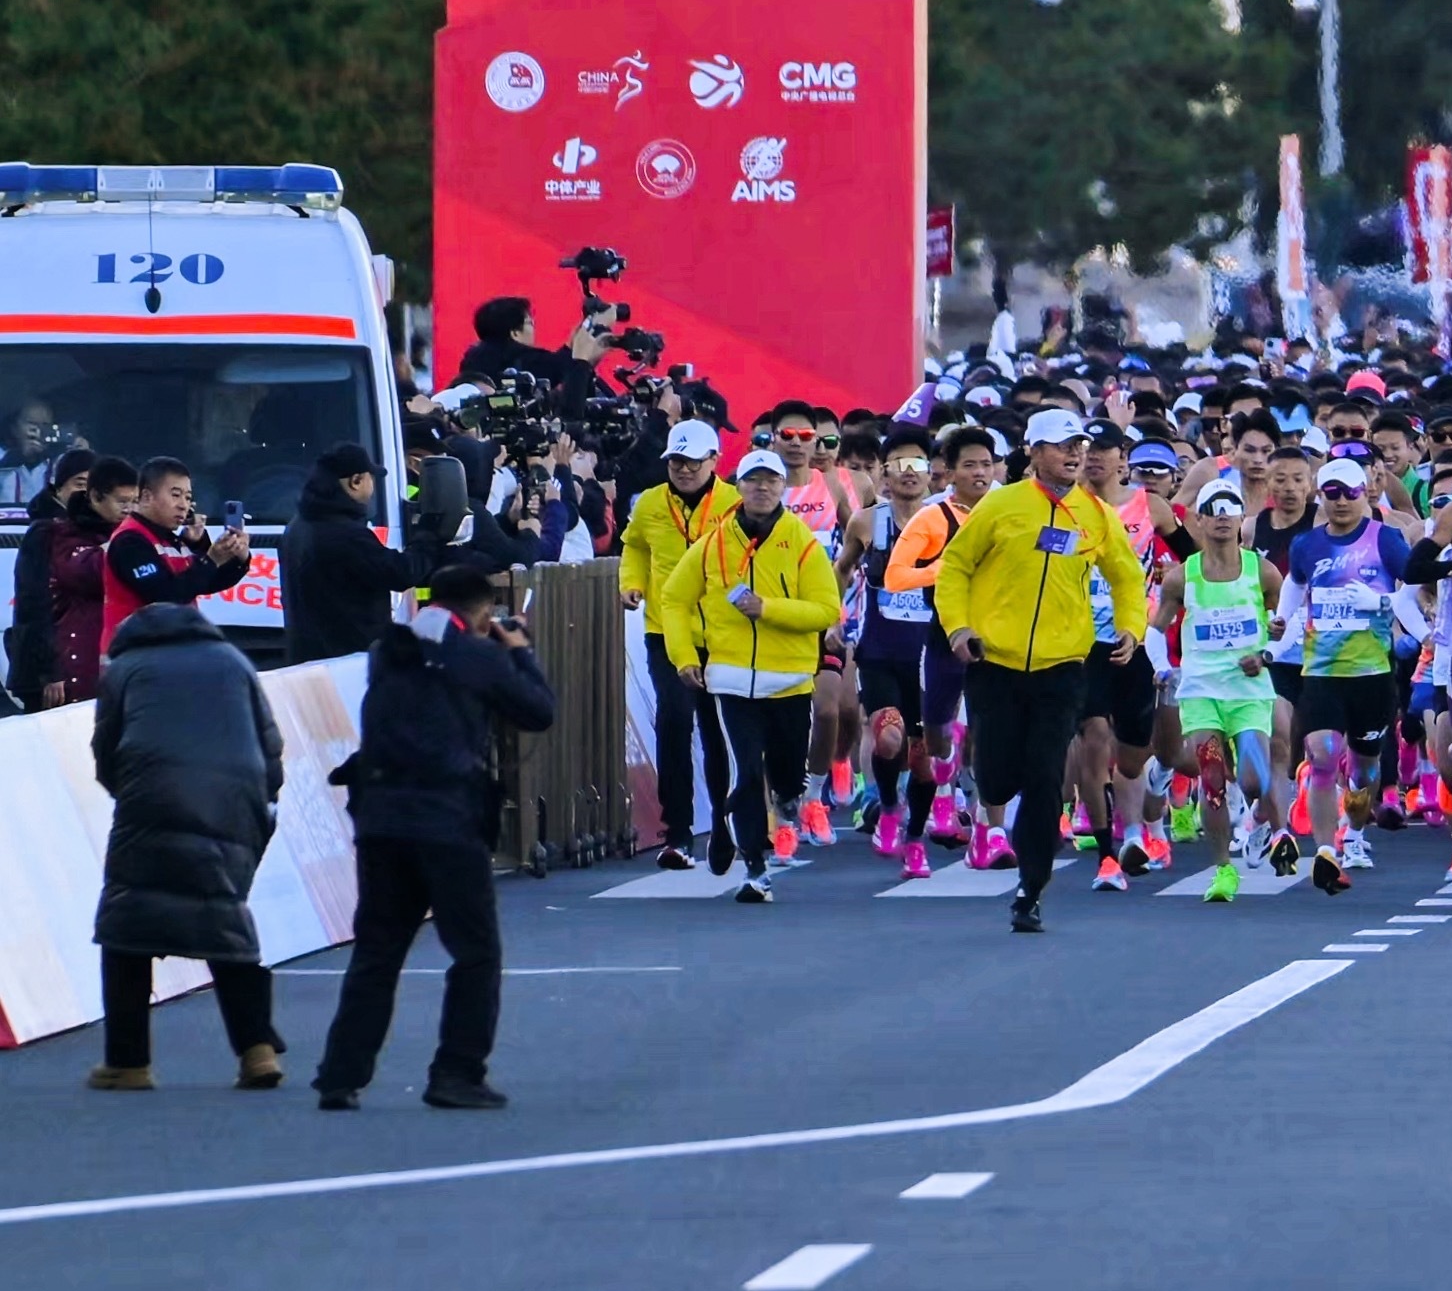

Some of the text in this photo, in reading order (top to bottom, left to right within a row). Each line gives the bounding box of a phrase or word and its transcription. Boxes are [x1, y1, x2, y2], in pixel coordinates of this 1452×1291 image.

[577, 71, 619, 83] CHINA
[778, 62, 857, 90] CMG
[731, 179, 796, 203] AIMS
[92, 252, 225, 285] 120
[132, 563, 157, 579] 120
[1320, 603, 1356, 617] A0373
[1209, 621, 1245, 637] A1529
